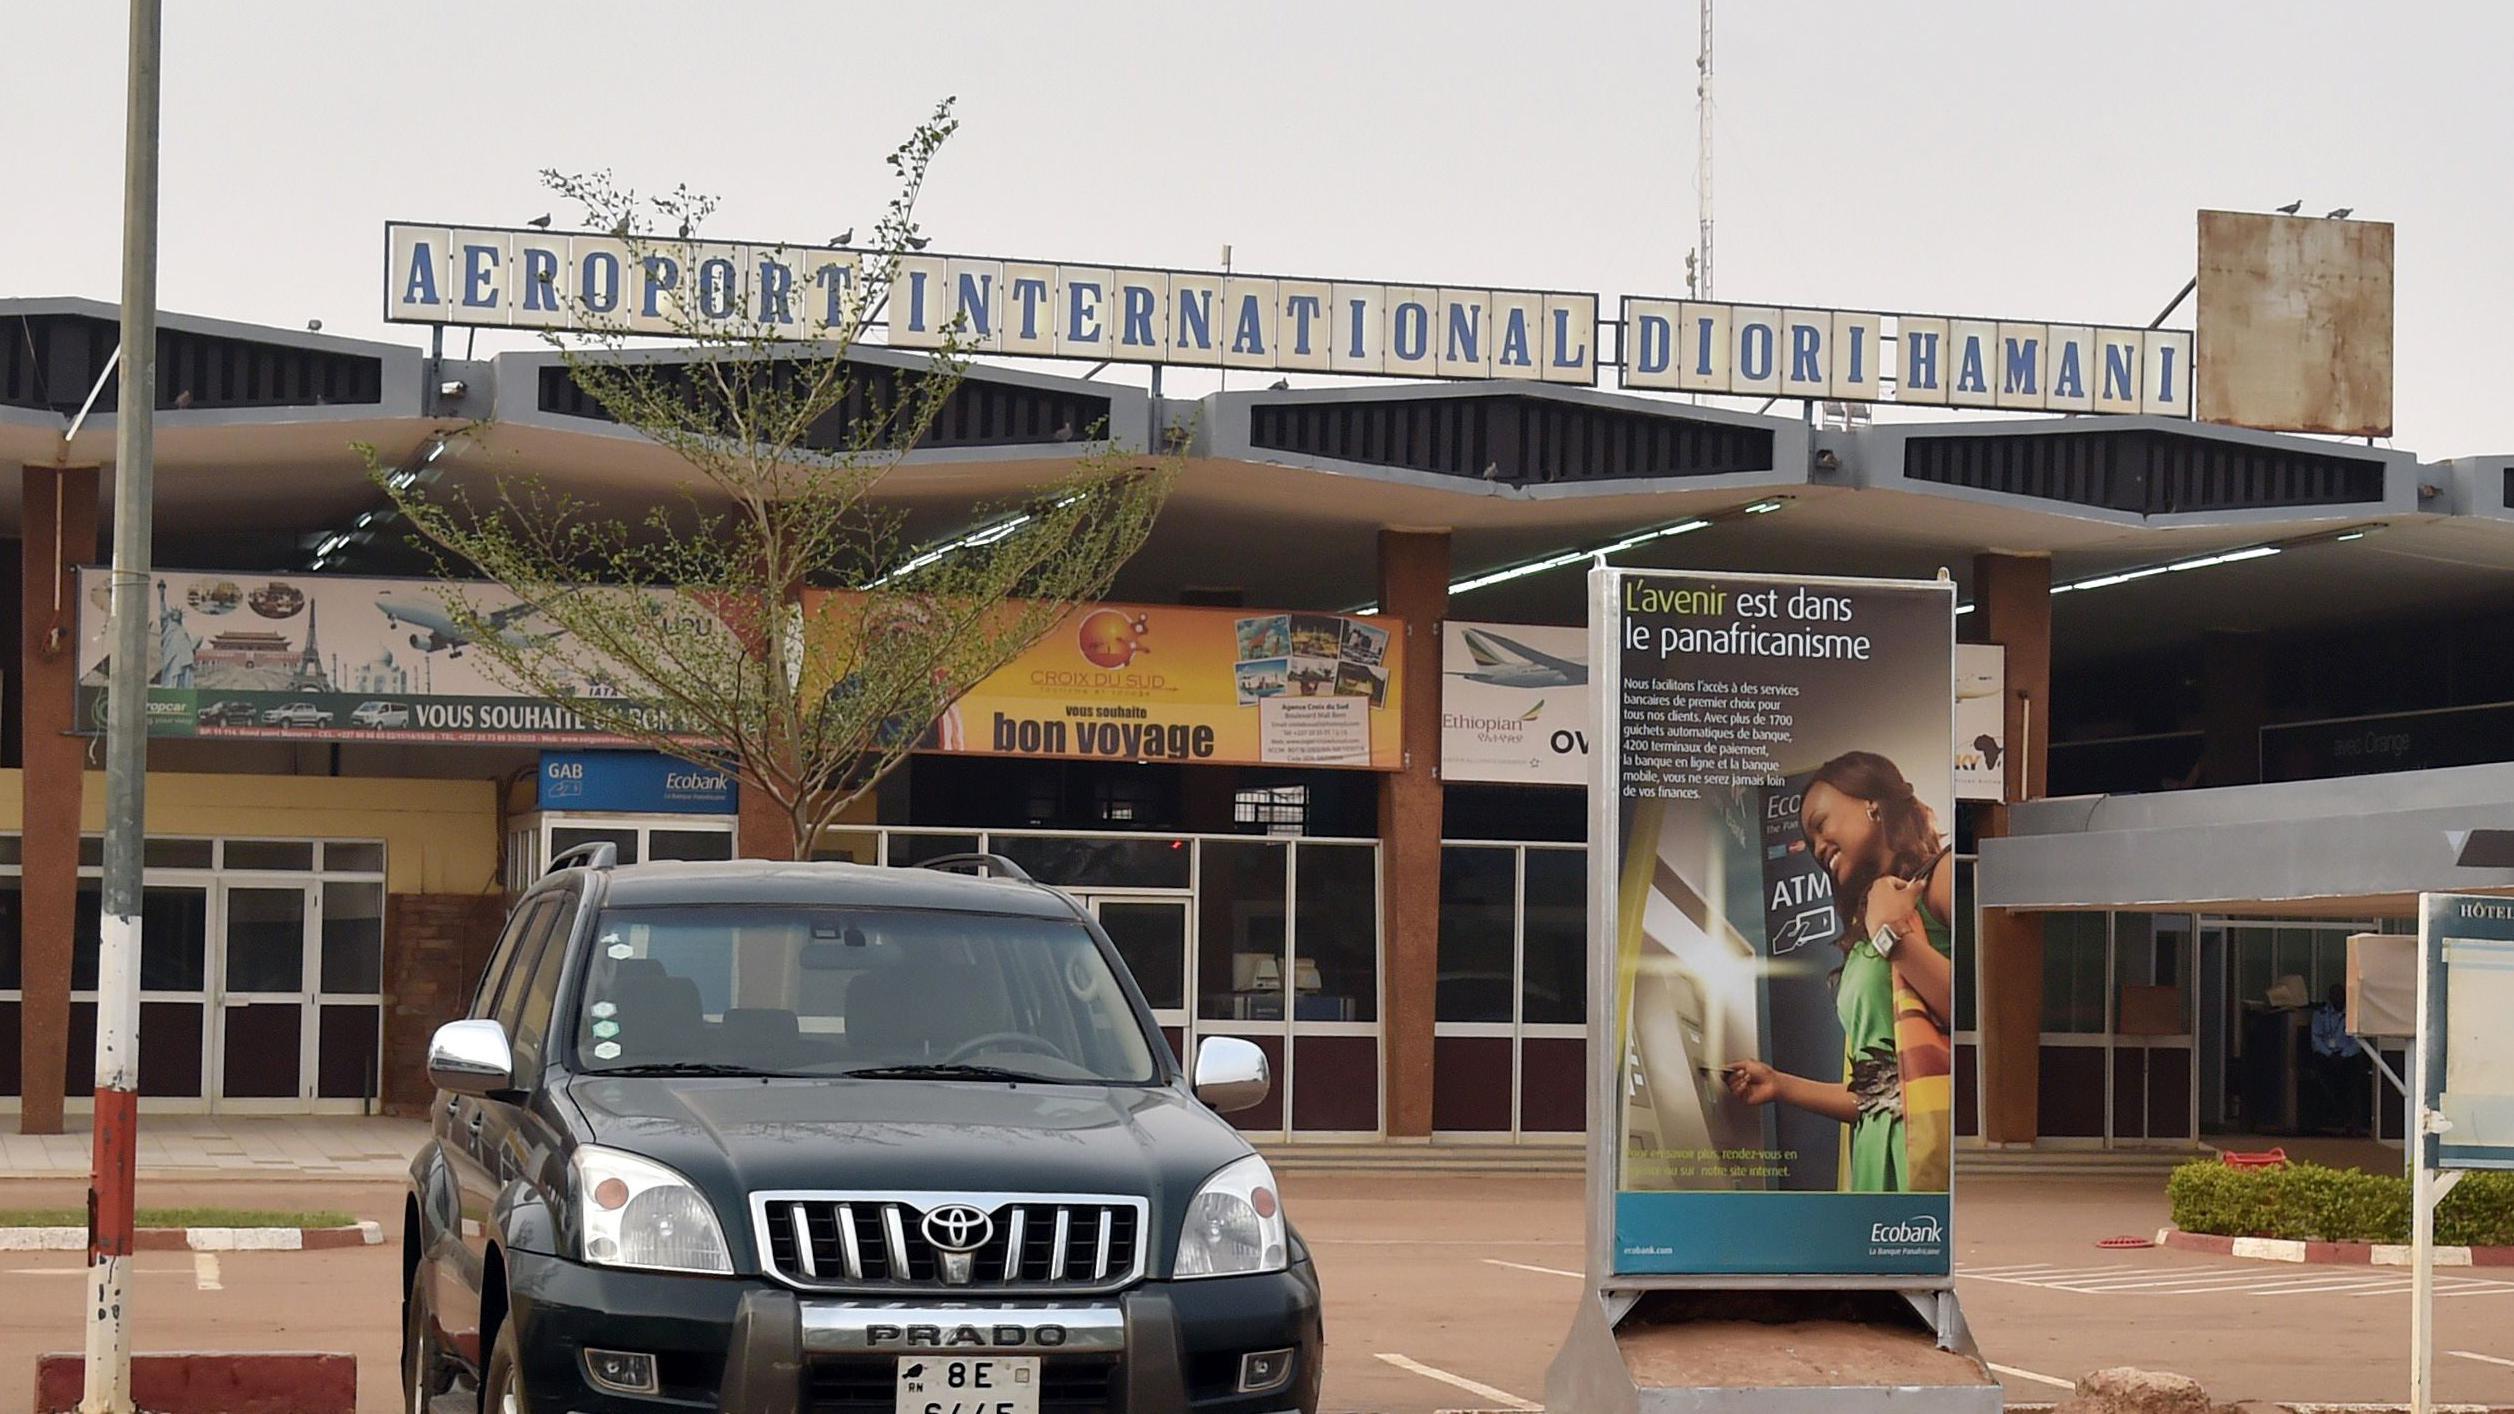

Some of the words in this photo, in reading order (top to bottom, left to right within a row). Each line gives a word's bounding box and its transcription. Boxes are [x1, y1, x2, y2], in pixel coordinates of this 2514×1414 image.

[403, 242, 852, 328] AEROPORT
[908, 272, 1586, 368] INTERNATIONAL
[1638, 314, 1865, 383] DIORI
[1908, 331, 2176, 402] HAMANI
[1626, 579, 1727, 615] L'avenir
[1736, 588, 1778, 618] est
[1787, 586, 1852, 622] dans
[1626, 616, 1650, 650] le
[1660, 621, 1871, 660] panafricanisme
[1030, 670, 1090, 686] CROIX
[1094, 672, 1121, 687] DU
[1126, 673, 1165, 688] SUD
[1623, 677, 1650, 690] Nous
[1652, 678, 1695, 692] facilitons
[1697, 679, 1729, 693] l'accès
[1731, 680, 1737, 693] à
[1740, 682, 1758, 695] des
[1760, 683, 1800, 697] services
[146, 702, 186, 713] ropcar
[1623, 692, 1670, 706] bancaires
[1673, 694, 1686, 706] de
[1688, 696, 1727, 709] premier
[1730, 697, 1756, 710] choix
[1758, 699, 1781, 712] pour
[415, 704, 474, 728] VOUS
[480, 704, 586, 731] SOUHAITE
[1065, 704, 1095, 718] vous
[1096, 705, 1147, 719] souhaite
[1623, 709, 1645, 721] tous
[1647, 711, 1665, 721] nos
[1667, 709, 1701, 723] clients.
[1703, 711, 1727, 724] Avec
[1730, 712, 1750, 726] plus
[1753, 713, 1766, 725] de
[1769, 714, 1793, 727] 1700
[1442, 713, 1523, 732] Ethiopian
[993, 711, 1067, 753] bon
[1076, 722, 1214, 760] voyage
[1550, 729, 1589, 754] OV
[1623, 725, 1665, 738] guichets
[1667, 726, 1735, 740] automatiques
[1737, 726, 1750, 738] de
[1753, 727, 1793, 743] banque,
[1623, 739, 1649, 751] 4200
[1651, 740, 1701, 753] terminaux
[1704, 741, 1717, 753] de
[1719, 742, 1769, 757] paiement,
[548, 762, 583, 779] GAB
[1623, 753, 1632, 766] la
[1635, 754, 1672, 769] banque
[1675, 757, 1688, 768] en
[1690, 756, 1714, 771] ligne
[1717, 757, 1728, 769] et
[1730, 757, 1740, 769] la
[1742, 758, 1779, 772] banque
[1955, 754, 1981, 771] KY
[666, 772, 728, 790] Ecobank
[1623, 770, 1660, 784] mobile,
[1663, 773, 1686, 783] vous
[1688, 774, 1701, 784] ne
[1704, 775, 1729, 785] serez
[1731, 773, 1764, 787] jamais
[1766, 774, 1785, 787] loin
[1622, 785, 1636, 797] de
[1639, 787, 1655, 798] vos
[1658, 785, 1701, 799] finances.
[1771, 871, 1833, 911] ATM
[1722, 1149, 1782, 1160] rendez-vous
[1784, 1151, 1798, 1161] en
[1680, 1167, 1695, 1176] sur
[1701, 1166, 1727, 1176] notre
[1730, 1165, 1747, 1176] site
[1749, 1165, 1790, 1177] internet.
[1871, 1220, 1944, 1244] Ecobank
[1623, 1245, 1673, 1255] ecobank.com
[865, 1323, 1068, 1347] PRADO
[908, 1382, 924, 1393] RN
